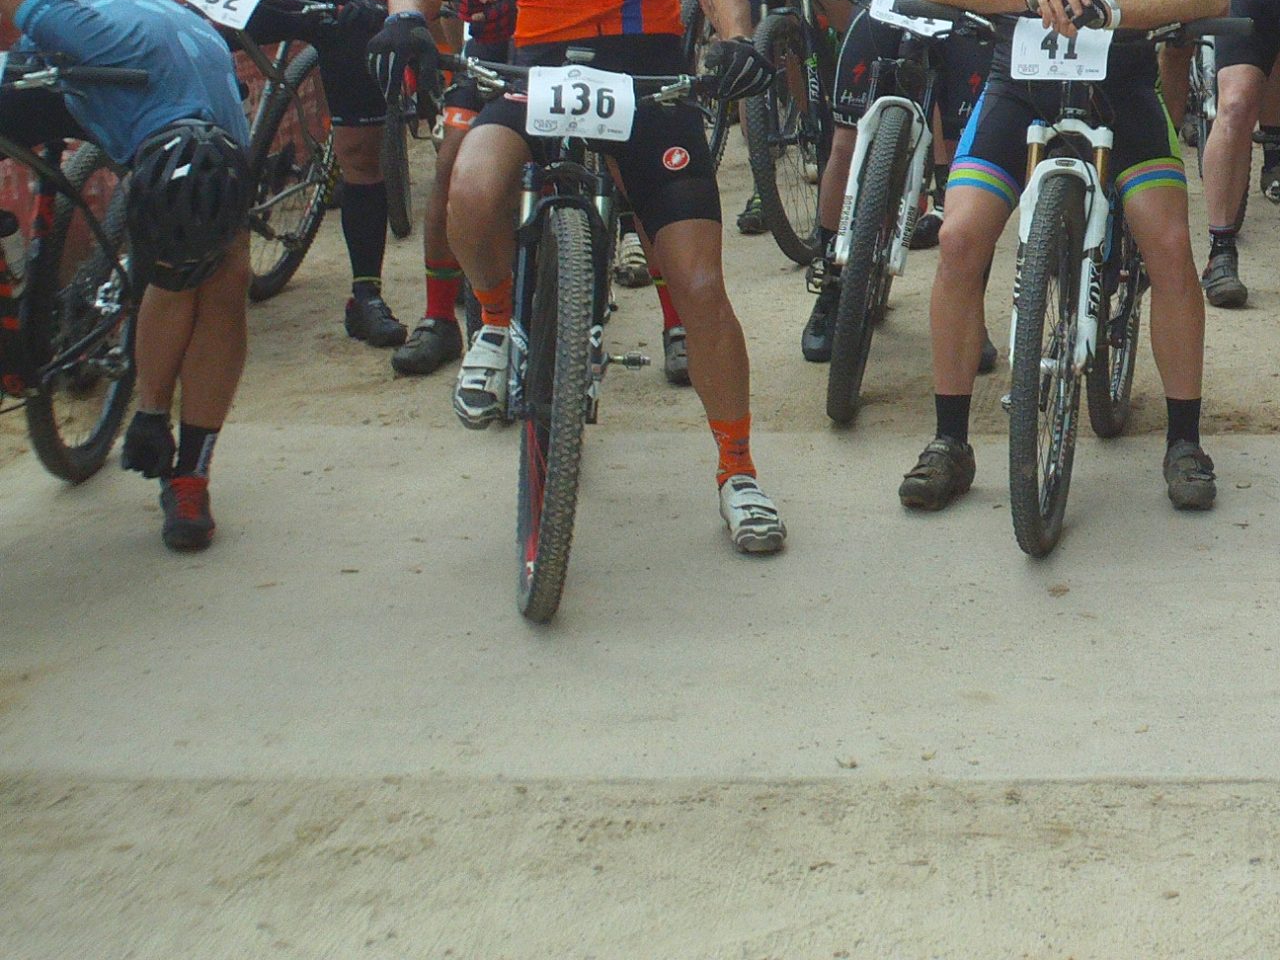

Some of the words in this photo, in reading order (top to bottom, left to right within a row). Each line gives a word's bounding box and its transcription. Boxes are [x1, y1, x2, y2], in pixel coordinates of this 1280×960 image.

[1040, 30, 1078, 60] 41
[549, 82, 616, 120] 136
[808, 66, 820, 102] FOX
[1087, 261, 1103, 318] FOX
